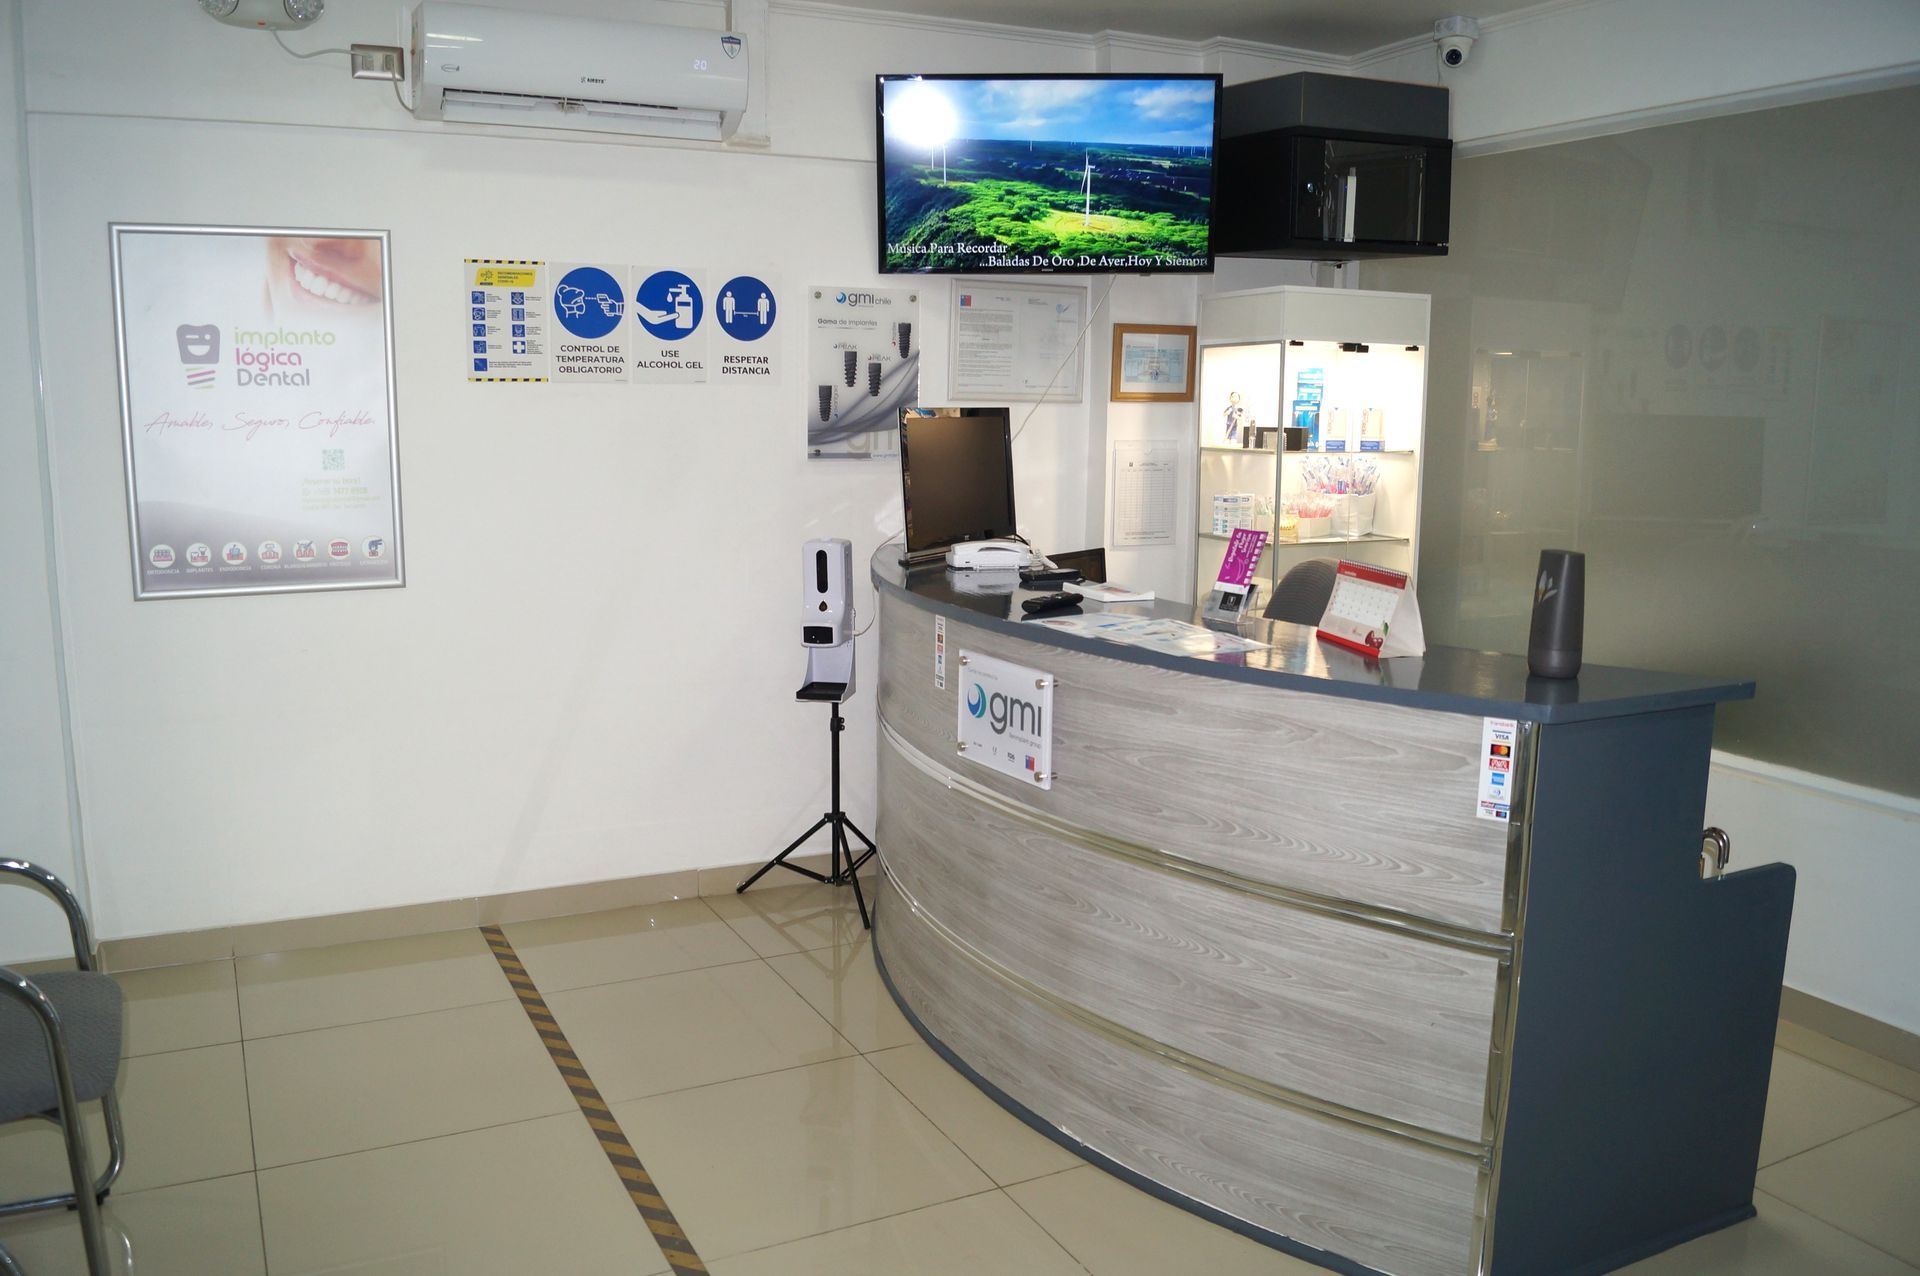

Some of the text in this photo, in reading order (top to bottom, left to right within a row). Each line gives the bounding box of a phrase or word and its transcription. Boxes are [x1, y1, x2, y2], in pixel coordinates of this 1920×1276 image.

[694, 59, 707, 71] 20
[887, 242, 1008, 254] Música Para Recordar
[1032, 256, 1049, 267] De
[1051, 255, 1075, 267] Oro
[1155, 255, 1163, 266] Y
[847, 292, 892, 307] gmi chile
[234, 327, 337, 349] implanto
[560, 345, 605, 353] CONTROL
[661, 350, 680, 358] USE
[235, 346, 303, 373] lógica
[556, 355, 625, 364] TEMPERATURA
[636, 361, 704, 370] ALCOHOL GEL
[723, 355, 769, 365] RESPETAR
[558, 366, 623, 374] OBLIGATORIO
[721, 366, 771, 375] DISTANCIA
[236, 367, 311, 387] Dental
[989, 692, 1042, 737] gmi
